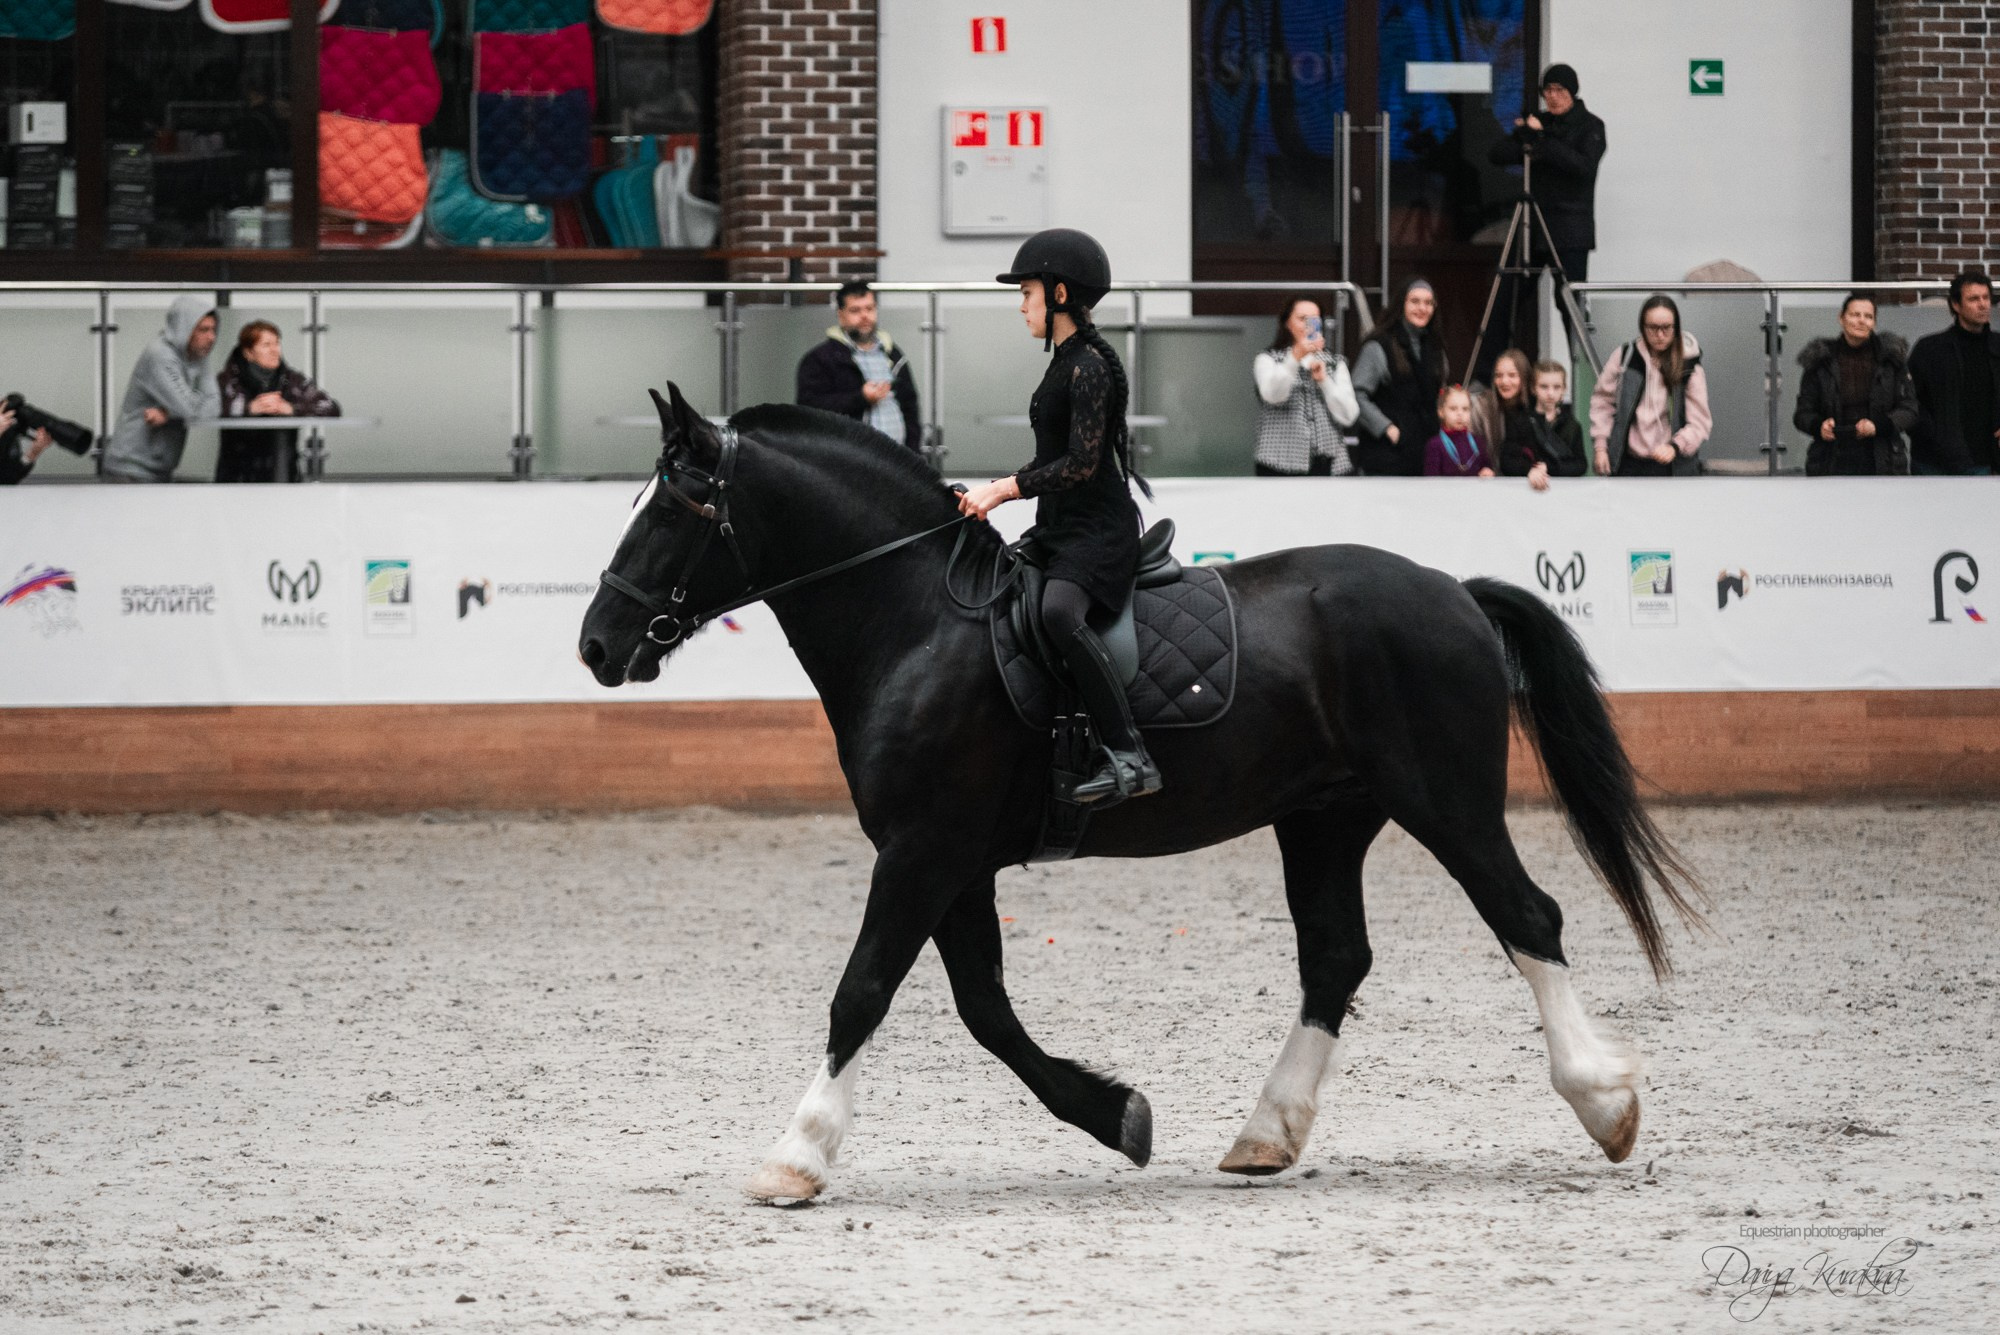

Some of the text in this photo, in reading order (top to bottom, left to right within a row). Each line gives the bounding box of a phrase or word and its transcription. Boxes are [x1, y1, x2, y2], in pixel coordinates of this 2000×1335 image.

[1755, 573, 1893, 589] РОСПЛЕМКОНЗАВОД
[121, 583, 215, 596] КРЫЛАТЫЙ
[121, 597, 215, 615] ЭКЛИПС
